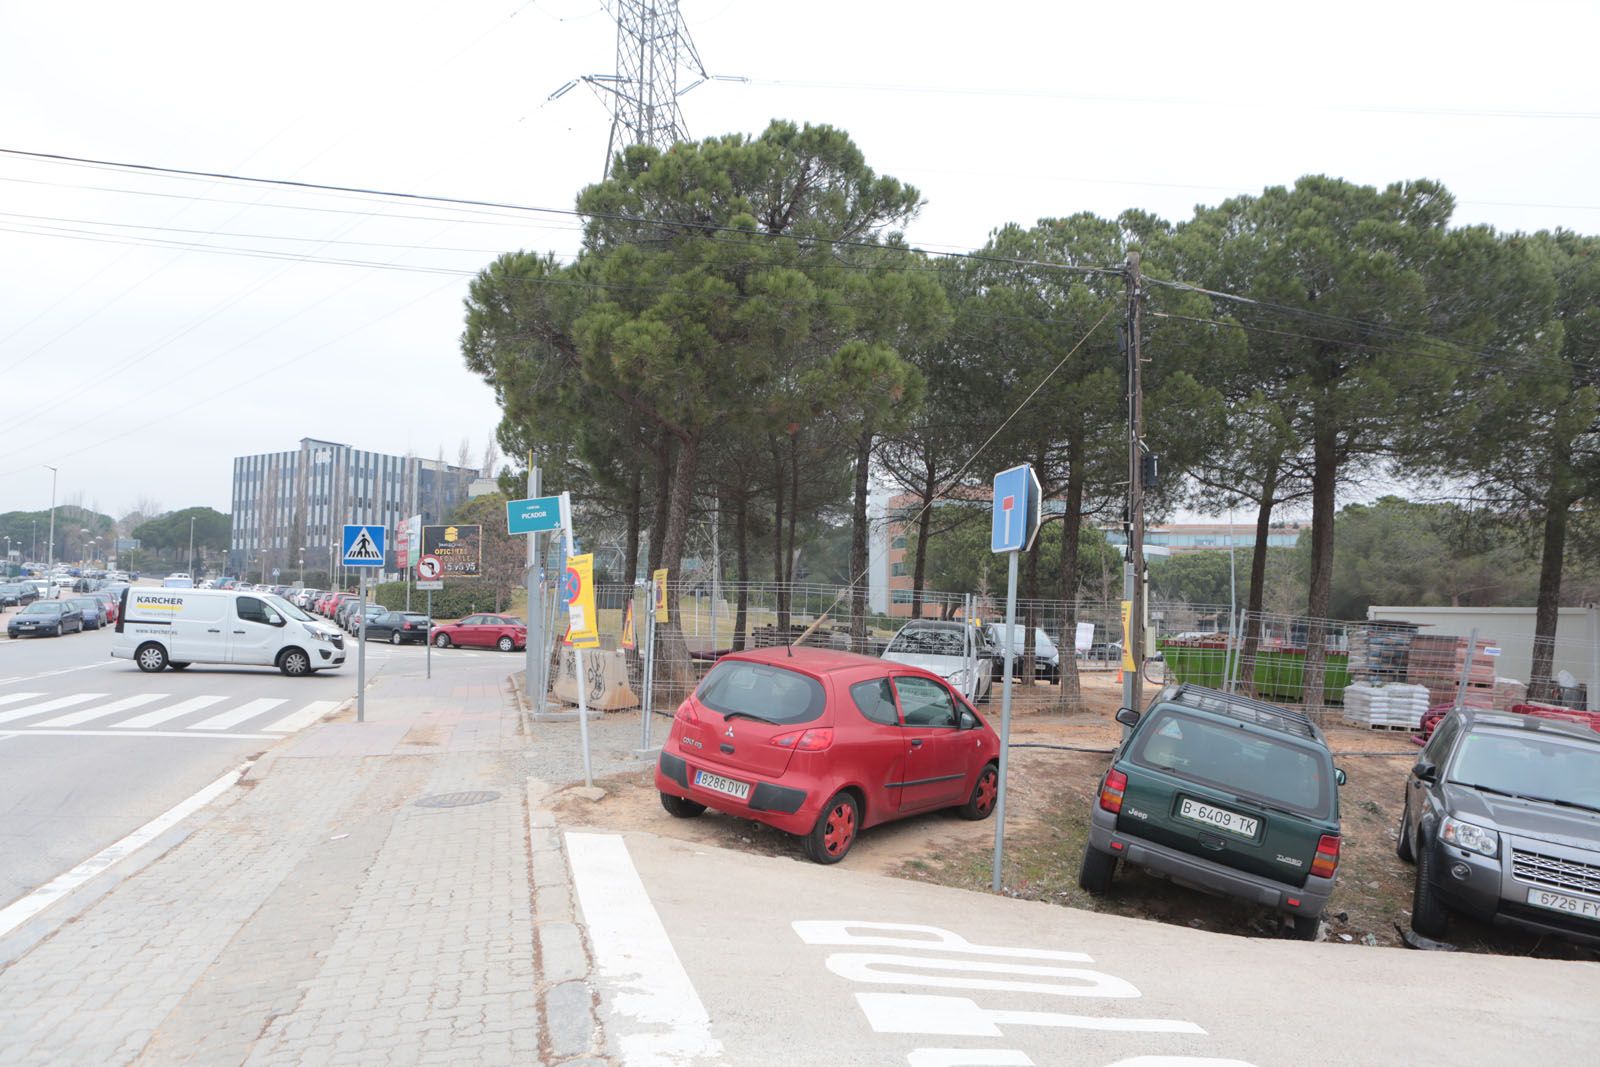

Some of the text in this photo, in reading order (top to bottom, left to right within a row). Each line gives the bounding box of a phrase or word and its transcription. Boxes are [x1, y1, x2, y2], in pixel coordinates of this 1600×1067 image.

[521, 511, 547, 519] PICADOR
[701, 774, 748, 797] 8286 DVV
[1128, 807, 1149, 820] Jeep
[1540, 893, 1577, 911] 6726
